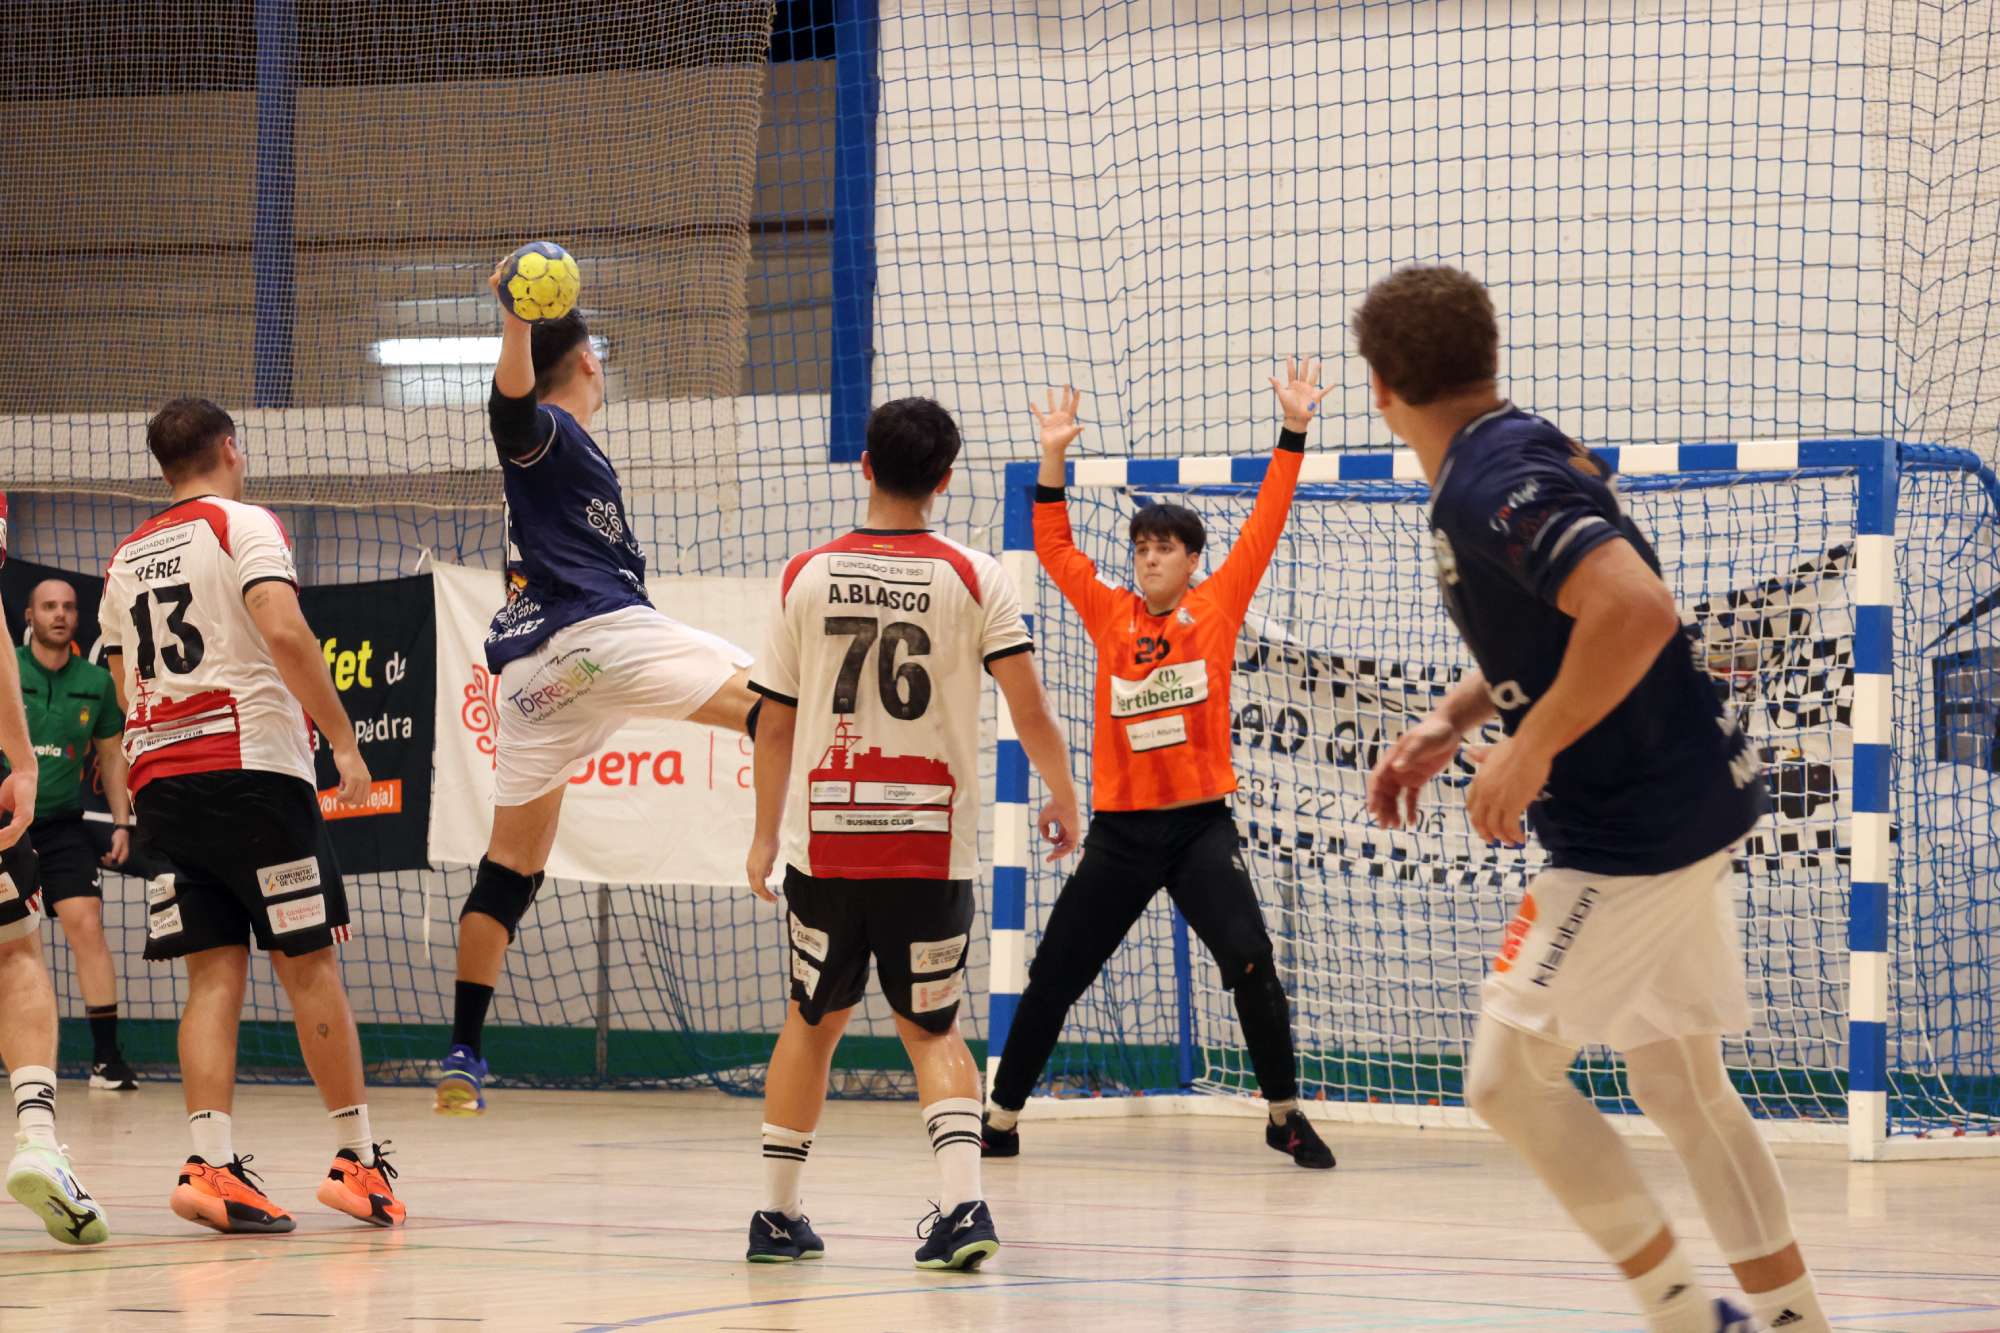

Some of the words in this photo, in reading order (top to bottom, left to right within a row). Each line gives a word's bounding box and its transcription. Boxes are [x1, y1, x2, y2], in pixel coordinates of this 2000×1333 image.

[130, 538, 166, 557] FUNDADO
[165, 536, 175, 544] EN
[135, 555, 181, 582] PÉREZ
[837, 560, 888, 573] FUNDADO
[890, 566, 903, 575] EN
[906, 567, 924, 576] 1951
[828, 583, 931, 614] A.BLASCO
[129, 582, 205, 681] 13
[317, 637, 374, 692] fet
[824, 615, 932, 721] 76
[846, 818, 889, 826] BUSINESS
[891, 818, 914, 826] CLUB
[275, 868, 313, 882] COMUNITAT
[290, 872, 318, 885] L'ESPORT
